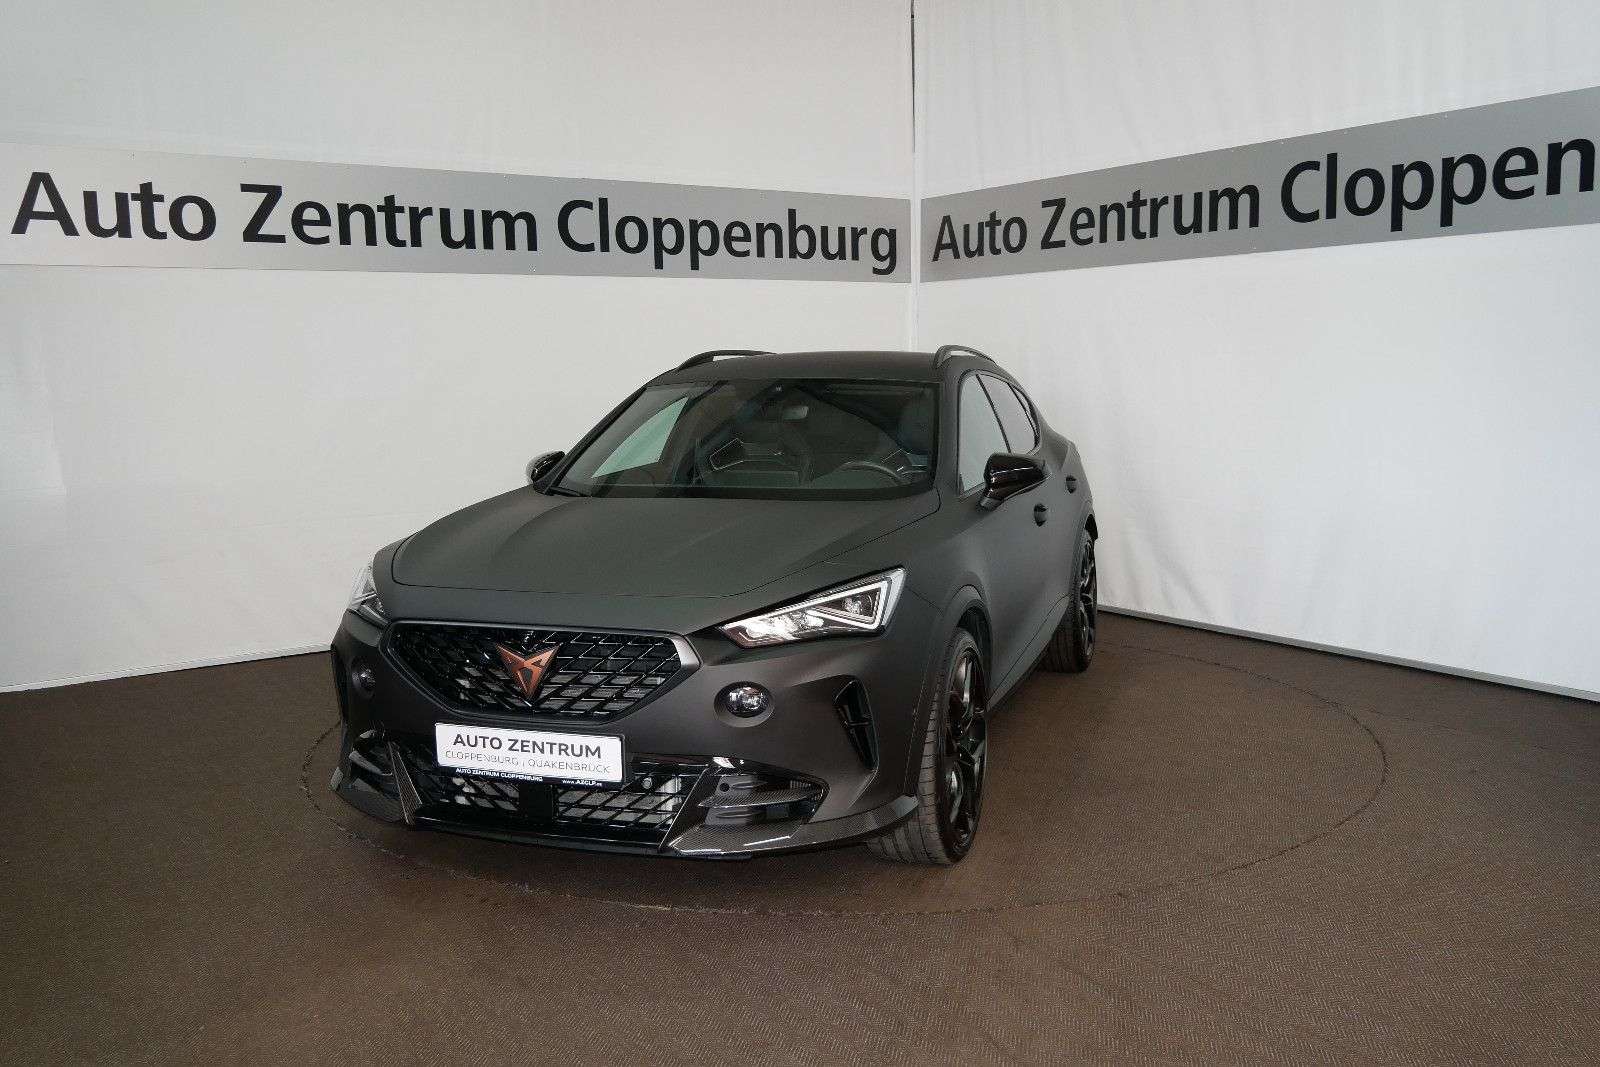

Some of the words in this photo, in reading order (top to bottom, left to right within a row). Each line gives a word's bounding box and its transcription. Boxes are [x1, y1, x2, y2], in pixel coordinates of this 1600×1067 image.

[932, 211, 1028, 262] Auto
[1040, 185, 1260, 250] Zentrum
[1280, 138, 1596, 233] Cloppen
[11, 172, 217, 243] Auto
[240, 184, 538, 252] Zentrum
[557, 197, 897, 276] Cloppenburg
[446, 750, 519, 766] CLOPPENBURG
[453, 733, 502, 750] AUTO
[508, 738, 602, 759] ZENTRUM
[472, 769, 500, 777] ZENTRUM
